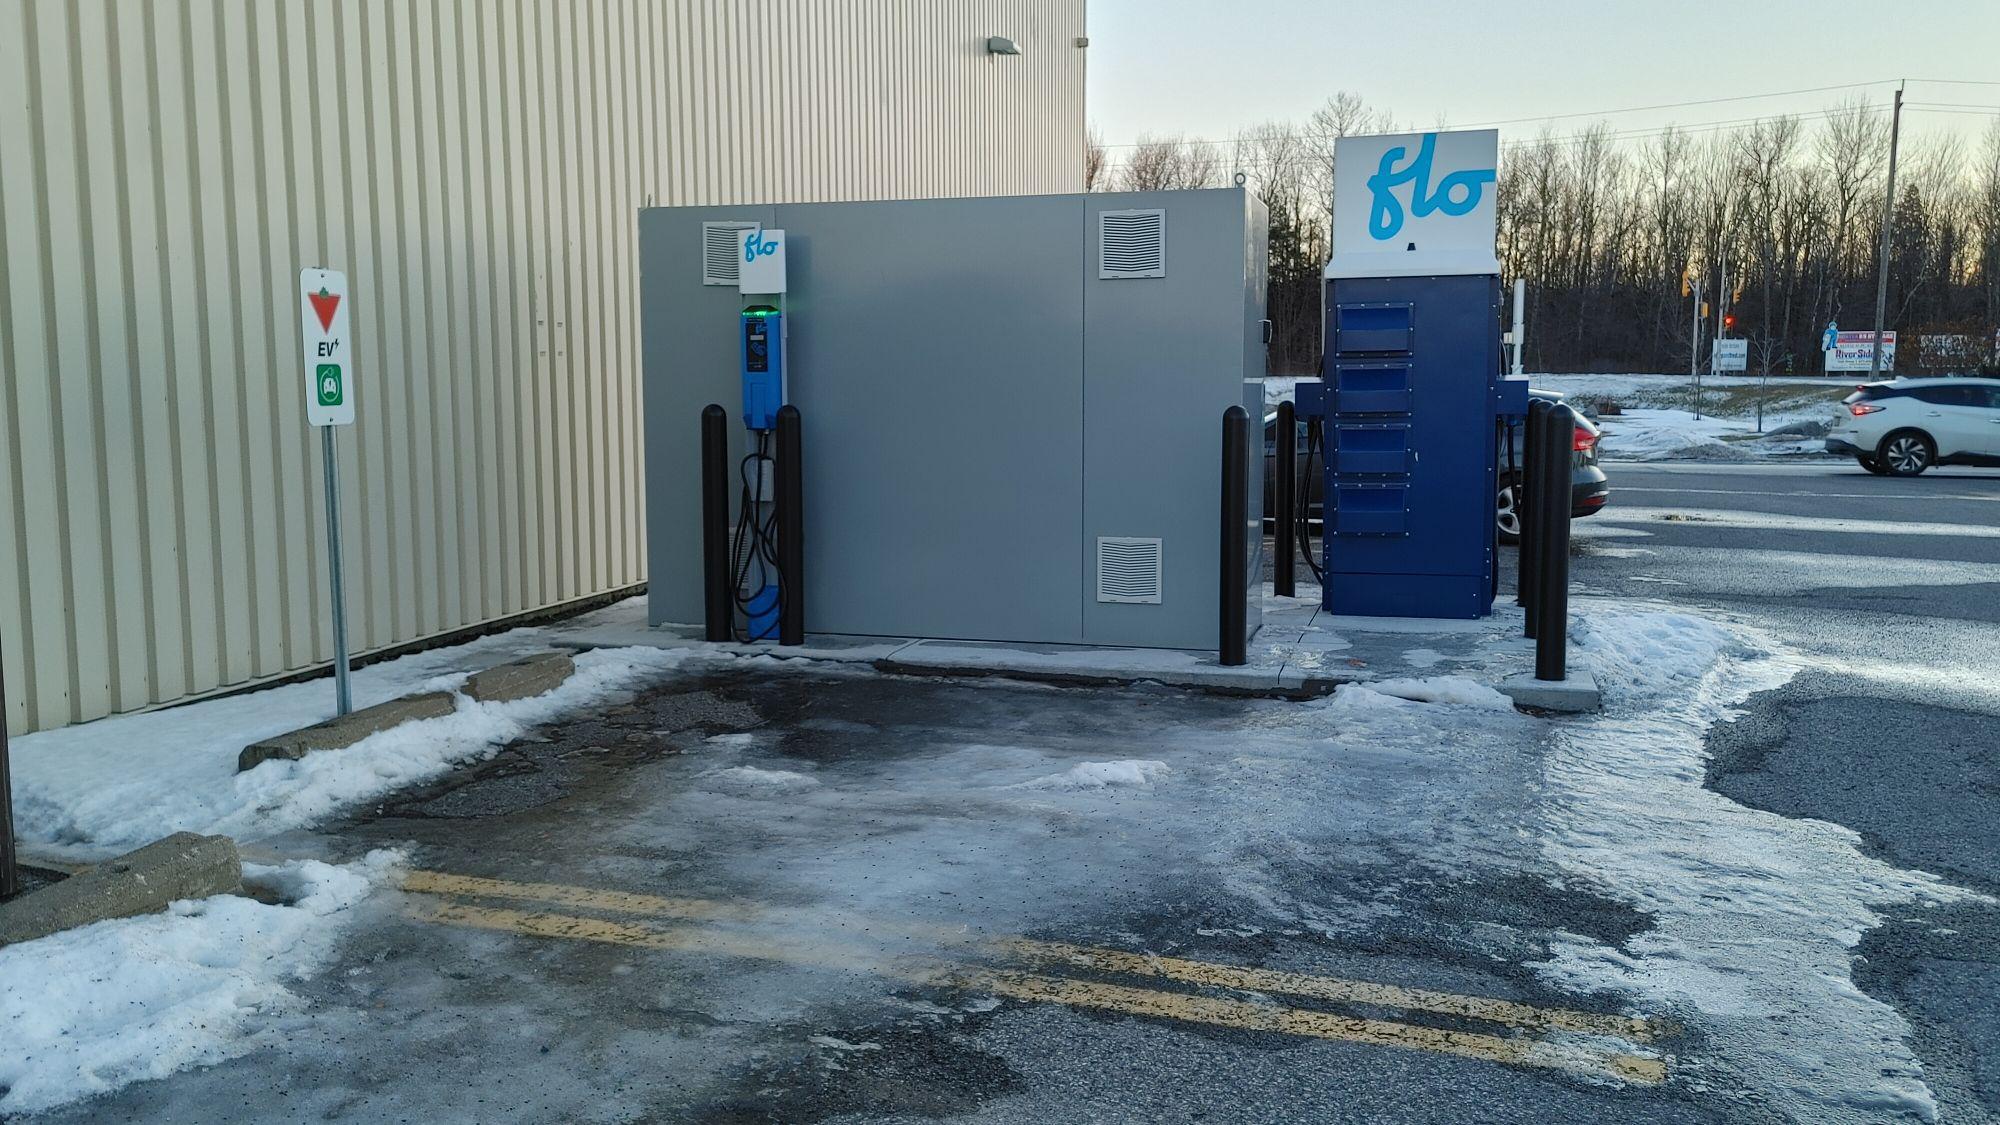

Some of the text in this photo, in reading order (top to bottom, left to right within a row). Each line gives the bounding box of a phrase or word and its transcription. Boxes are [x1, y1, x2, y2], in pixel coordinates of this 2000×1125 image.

[1367, 133, 1496, 240] flo
[744, 228, 778, 262] flo
[318, 342, 335, 357] EV
